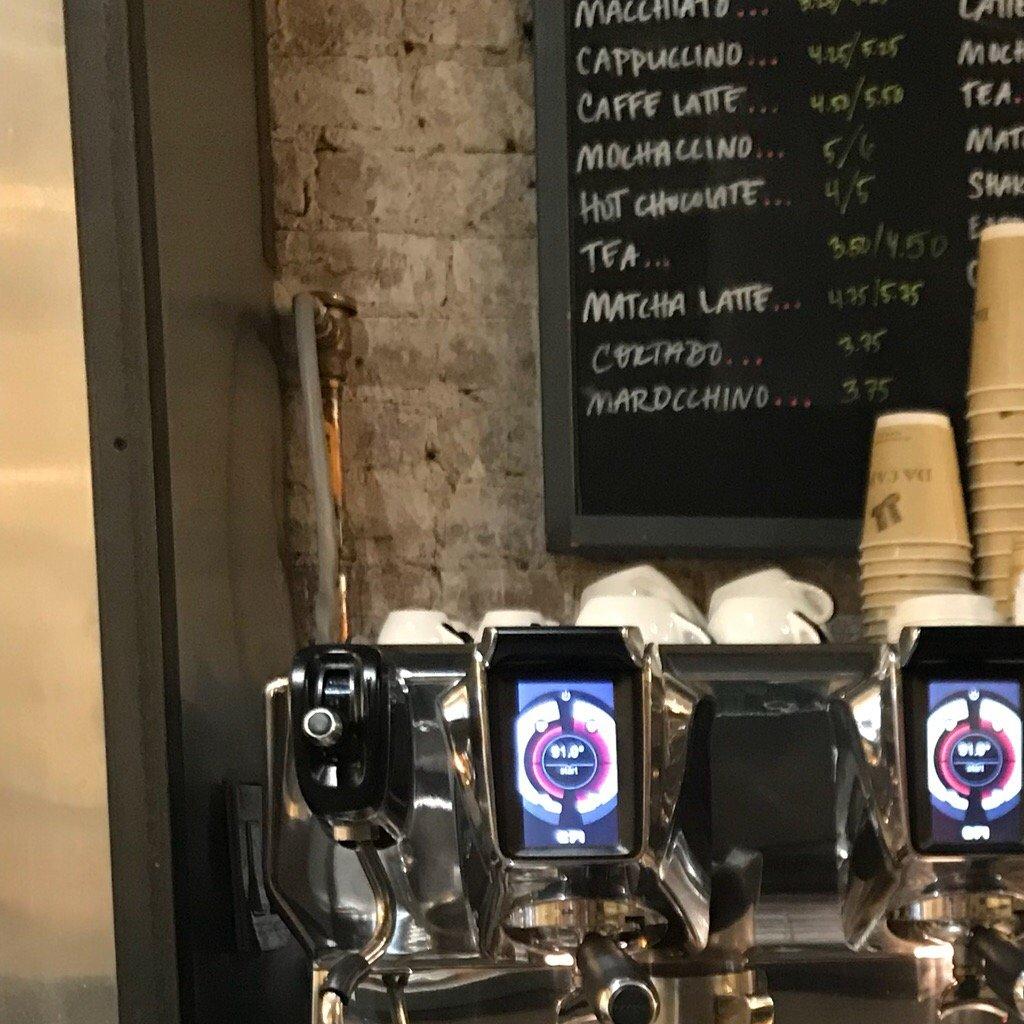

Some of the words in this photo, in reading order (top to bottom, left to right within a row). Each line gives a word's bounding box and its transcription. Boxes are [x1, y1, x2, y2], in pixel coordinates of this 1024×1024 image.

[577, 90, 662, 123] CAFFE
[580, 188, 630, 225] HOT
[582, 288, 687, 323] MATCHA
